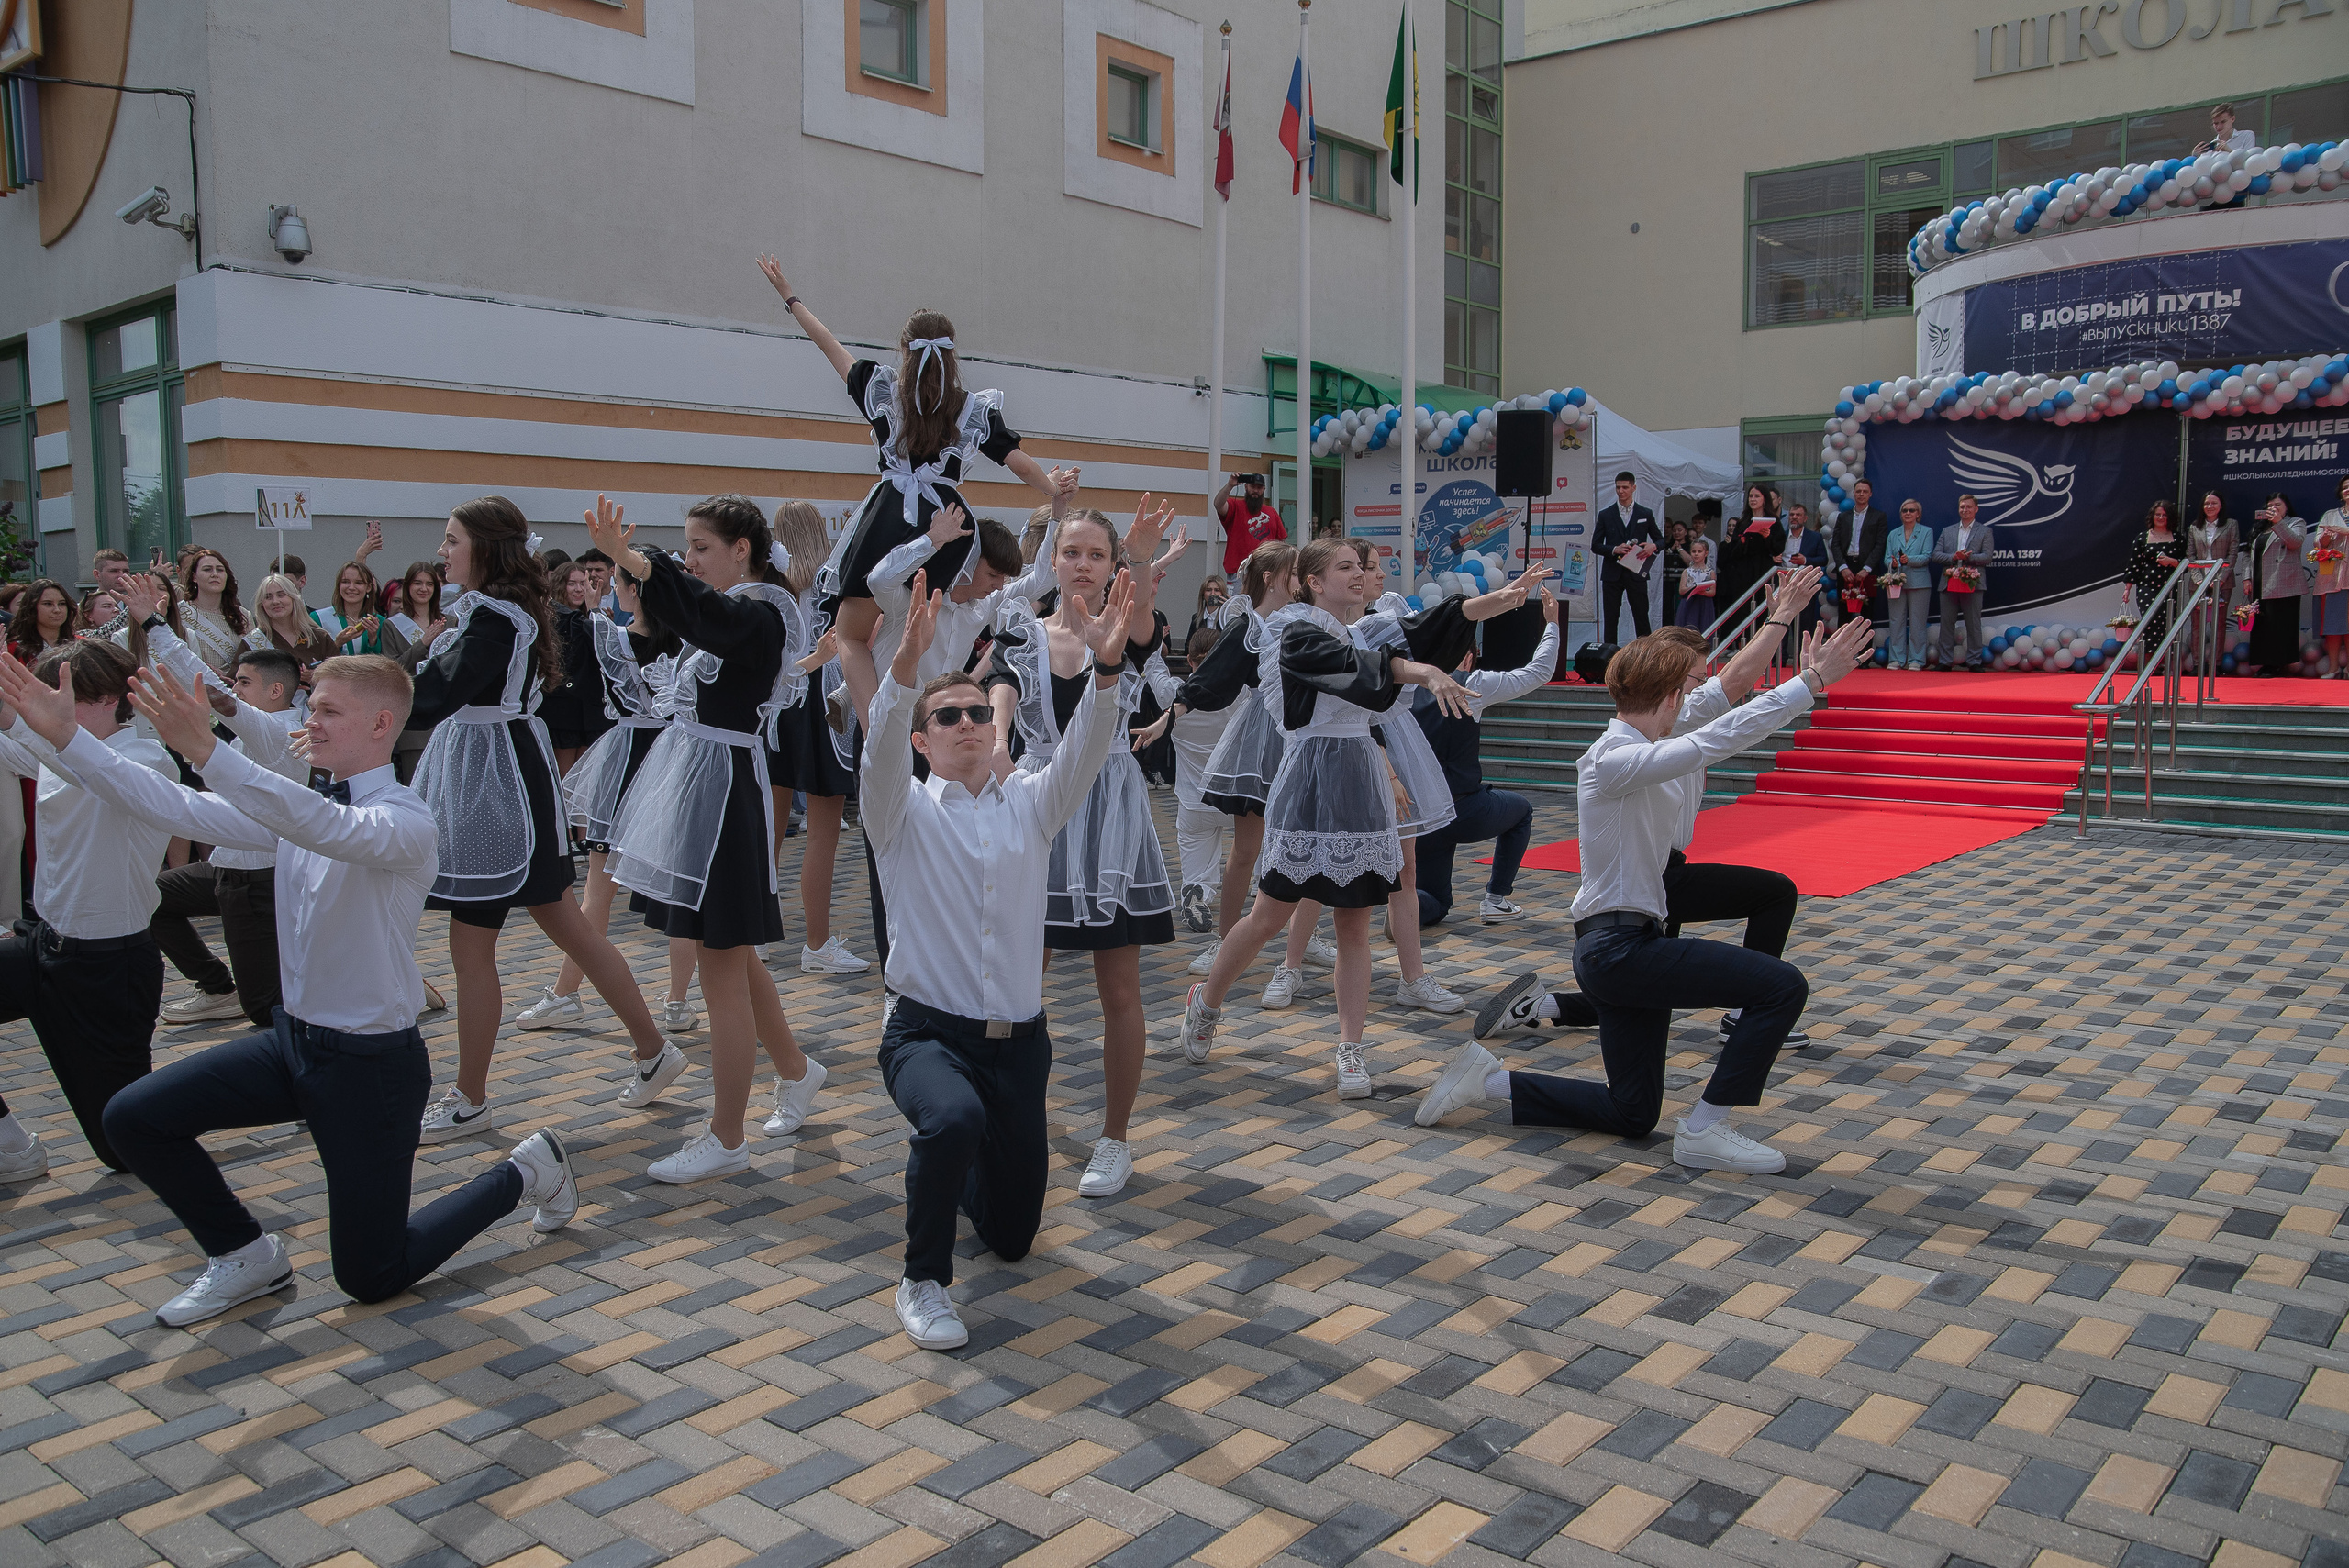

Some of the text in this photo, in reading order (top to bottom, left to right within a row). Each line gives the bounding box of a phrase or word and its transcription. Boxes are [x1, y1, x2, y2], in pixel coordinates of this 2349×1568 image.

[2021, 288, 2242, 331] В ДОБРЫЙ ПУТЬ!
[2225, 417, 2349, 442] БУДУЩЕЕ
[2223, 439, 2339, 465] ЗНАНИЙ!
[1453, 487, 1478, 496] Успех
[1439, 496, 1492, 506] начинается
[1452, 506, 1480, 519] здесь!
[2017, 550, 2043, 559] 1387
